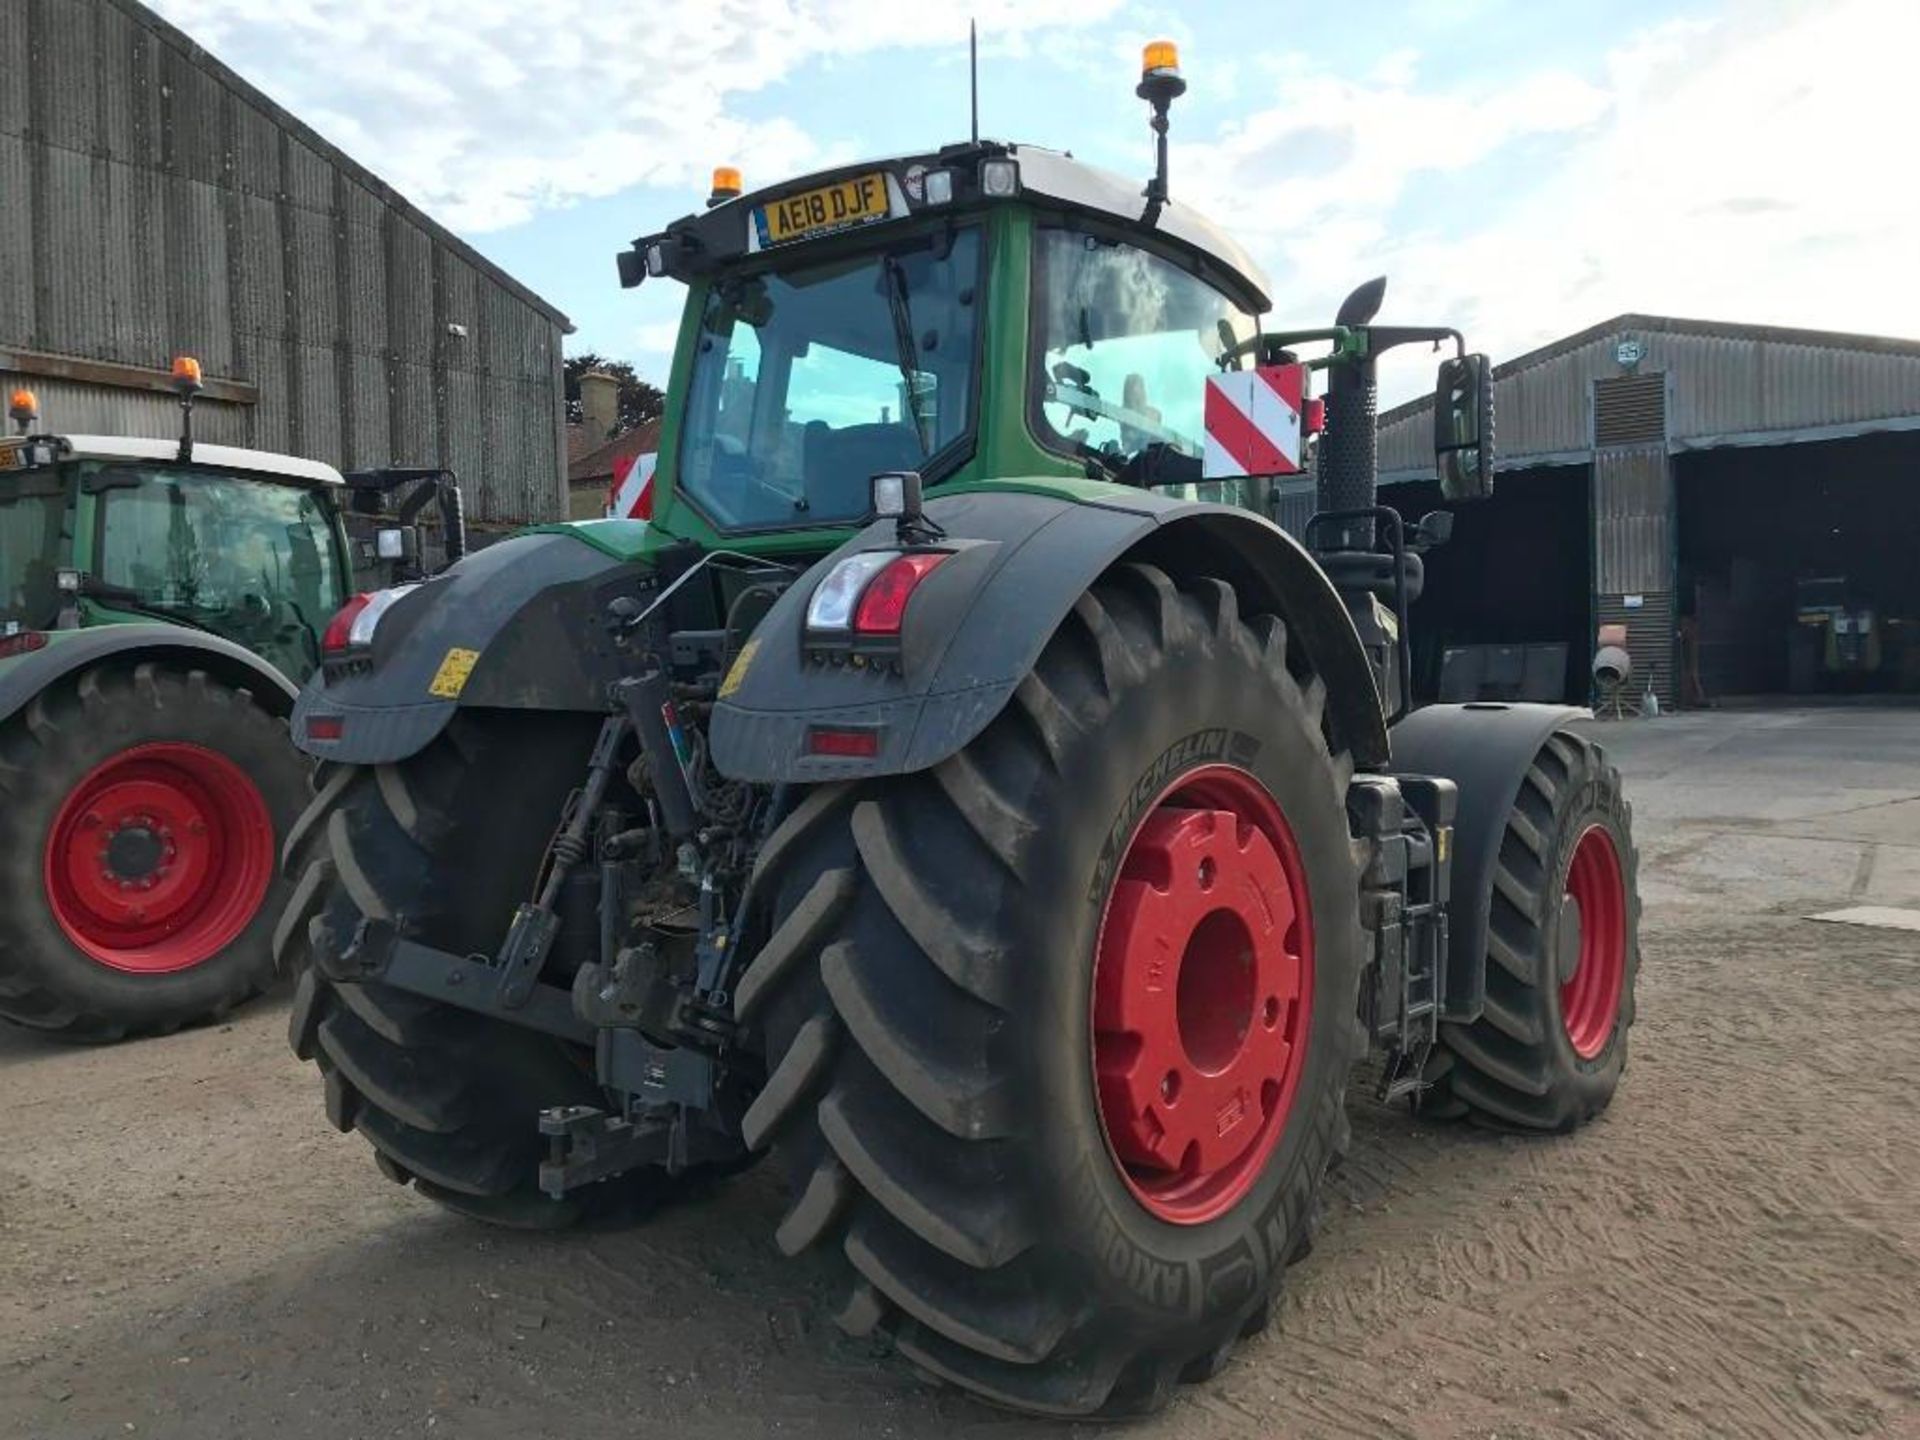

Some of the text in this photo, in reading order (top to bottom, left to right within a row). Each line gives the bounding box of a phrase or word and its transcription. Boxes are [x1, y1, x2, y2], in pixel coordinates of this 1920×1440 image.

[777, 191, 826, 234] AE18
[832, 180, 876, 222] DJF
[1111, 731, 1226, 848] MICHELIN
